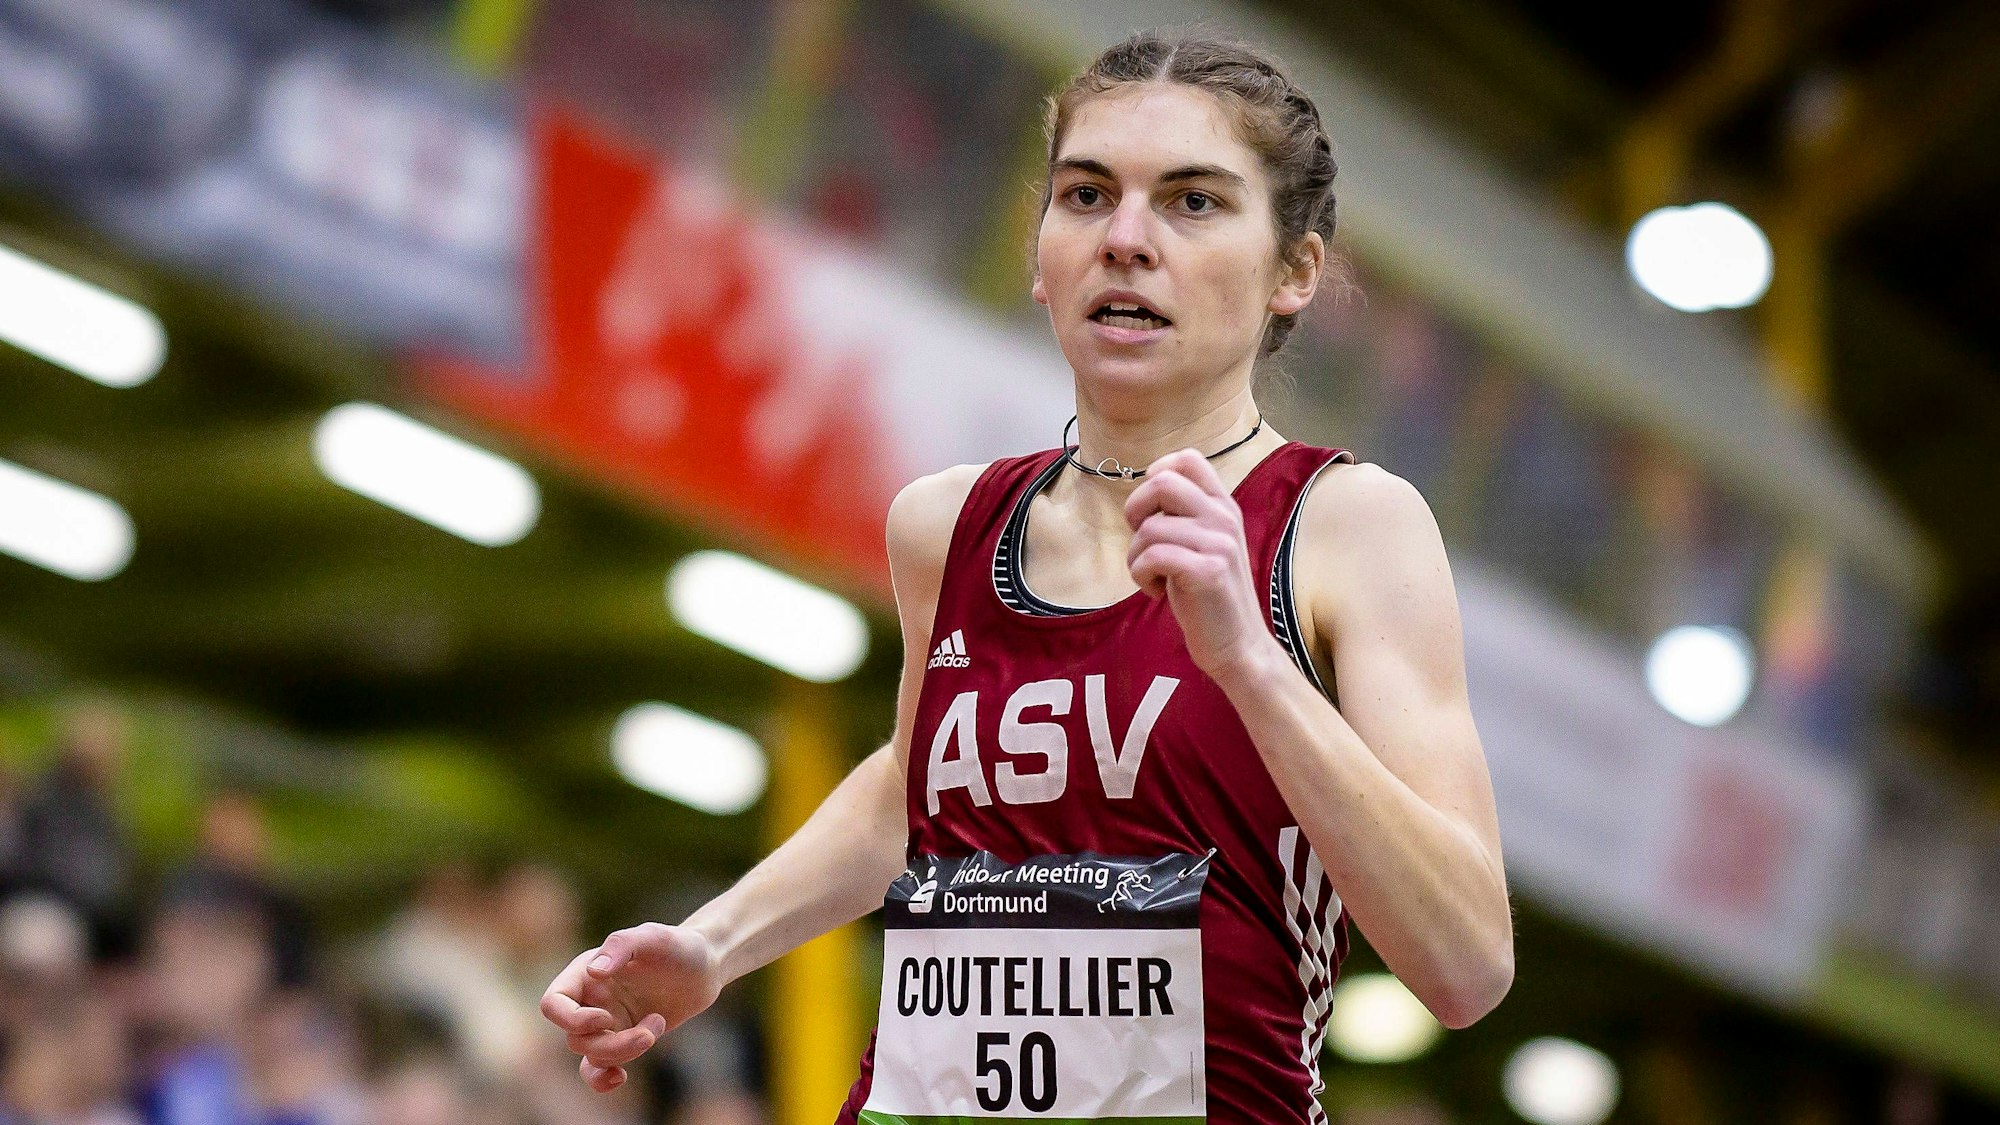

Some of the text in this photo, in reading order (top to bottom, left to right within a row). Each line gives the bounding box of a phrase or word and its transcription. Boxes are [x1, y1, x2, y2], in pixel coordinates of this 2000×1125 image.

[928, 653, 970, 669] adidas
[927, 674, 1180, 817] ASV
[1016, 862, 1109, 889] Meeting
[944, 891, 1047, 913] Dortmund
[898, 957, 1174, 1017] COUTELLIER
[975, 1031, 1058, 1112] 50
